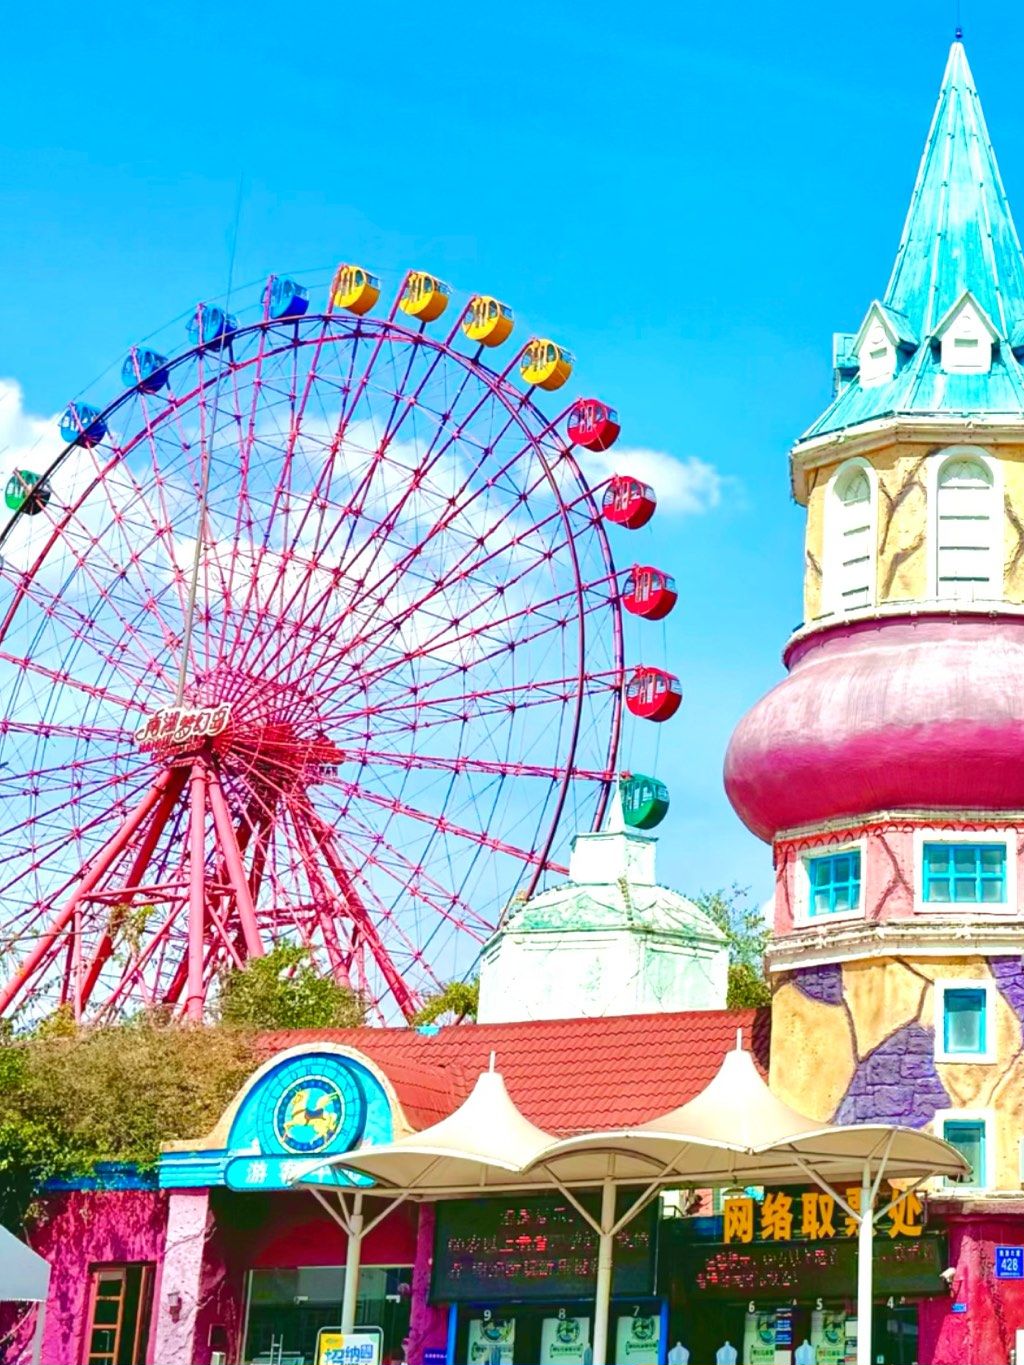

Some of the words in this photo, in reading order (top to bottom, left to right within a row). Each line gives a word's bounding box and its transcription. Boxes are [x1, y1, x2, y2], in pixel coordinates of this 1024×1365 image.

[1001, 1258, 1019, 1271] 428
[749, 1301, 755, 1312] 6
[816, 1298, 823, 1310] 5
[887, 1297, 894, 1309] 4
[483, 1309, 491, 1321] 9
[558, 1308, 566, 1319] 8
[633, 1306, 640, 1317] 7
